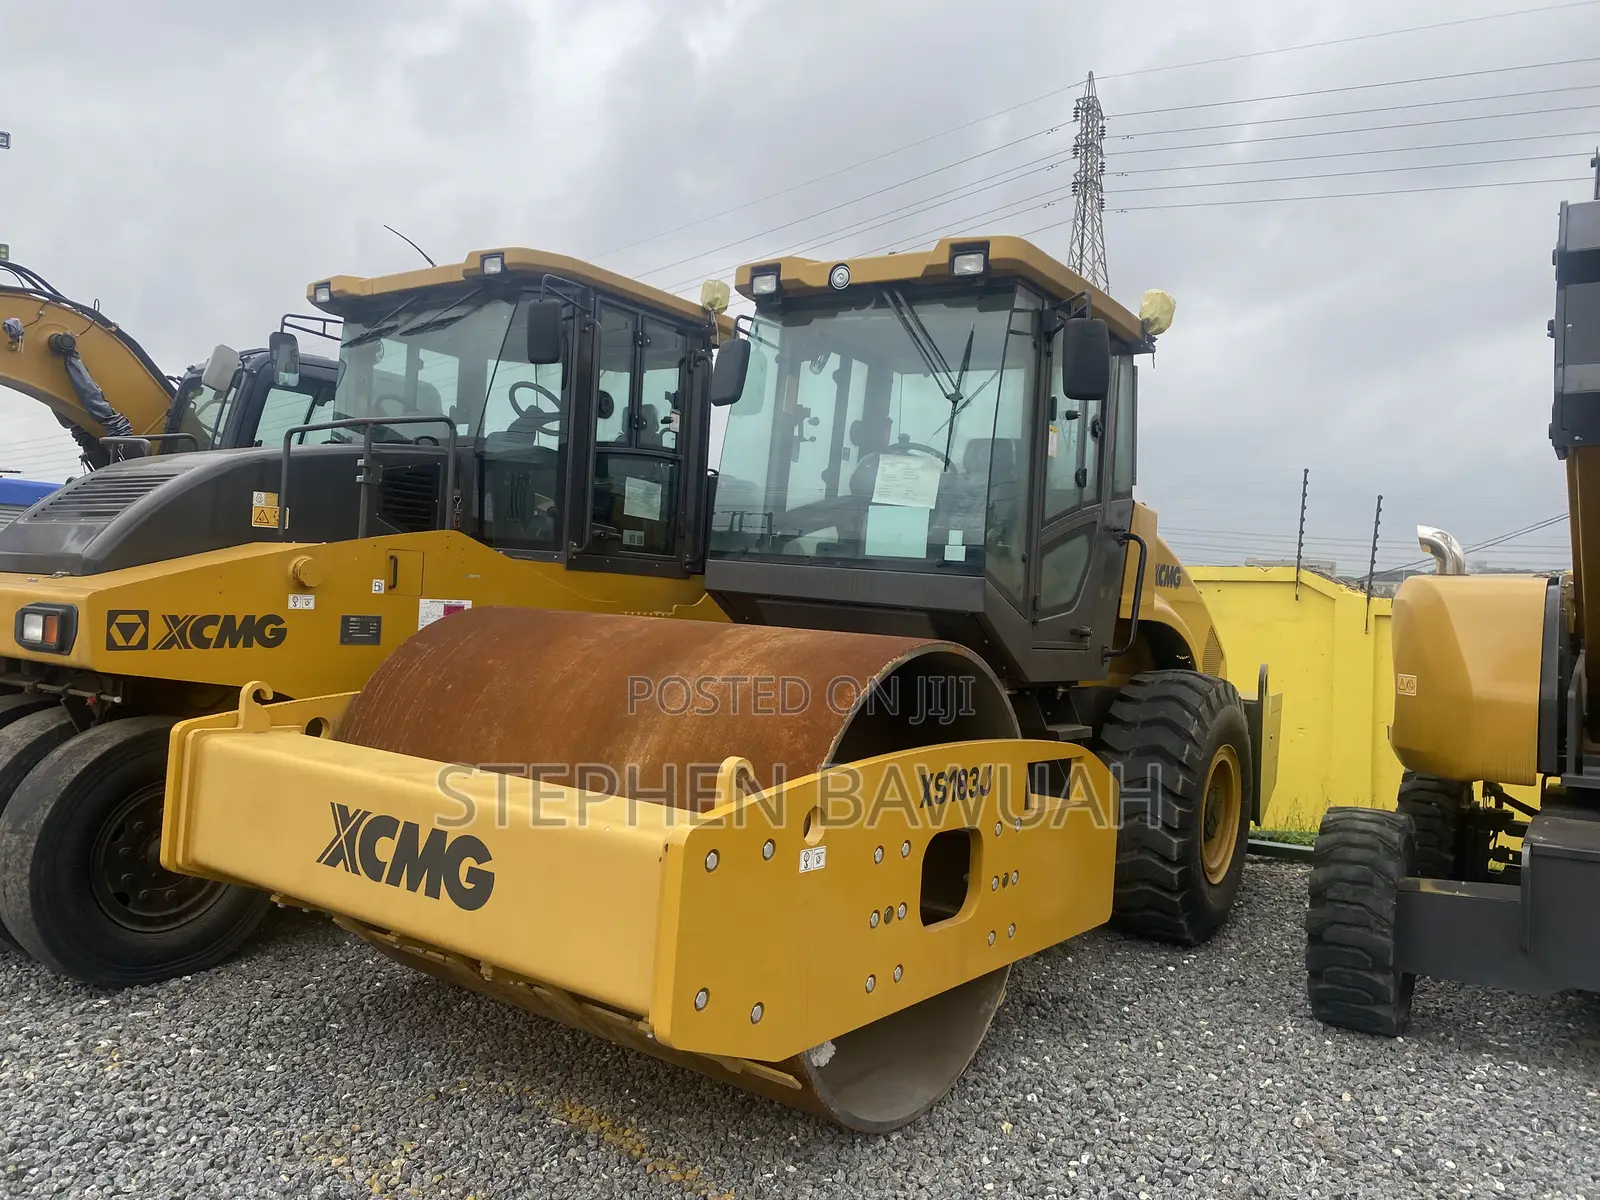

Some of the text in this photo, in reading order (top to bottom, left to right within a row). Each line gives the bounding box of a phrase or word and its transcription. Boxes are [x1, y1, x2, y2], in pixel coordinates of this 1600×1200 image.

[151, 613, 288, 651] XCMG
[919, 764, 993, 809] XS183J
[316, 801, 496, 912] XCMG
